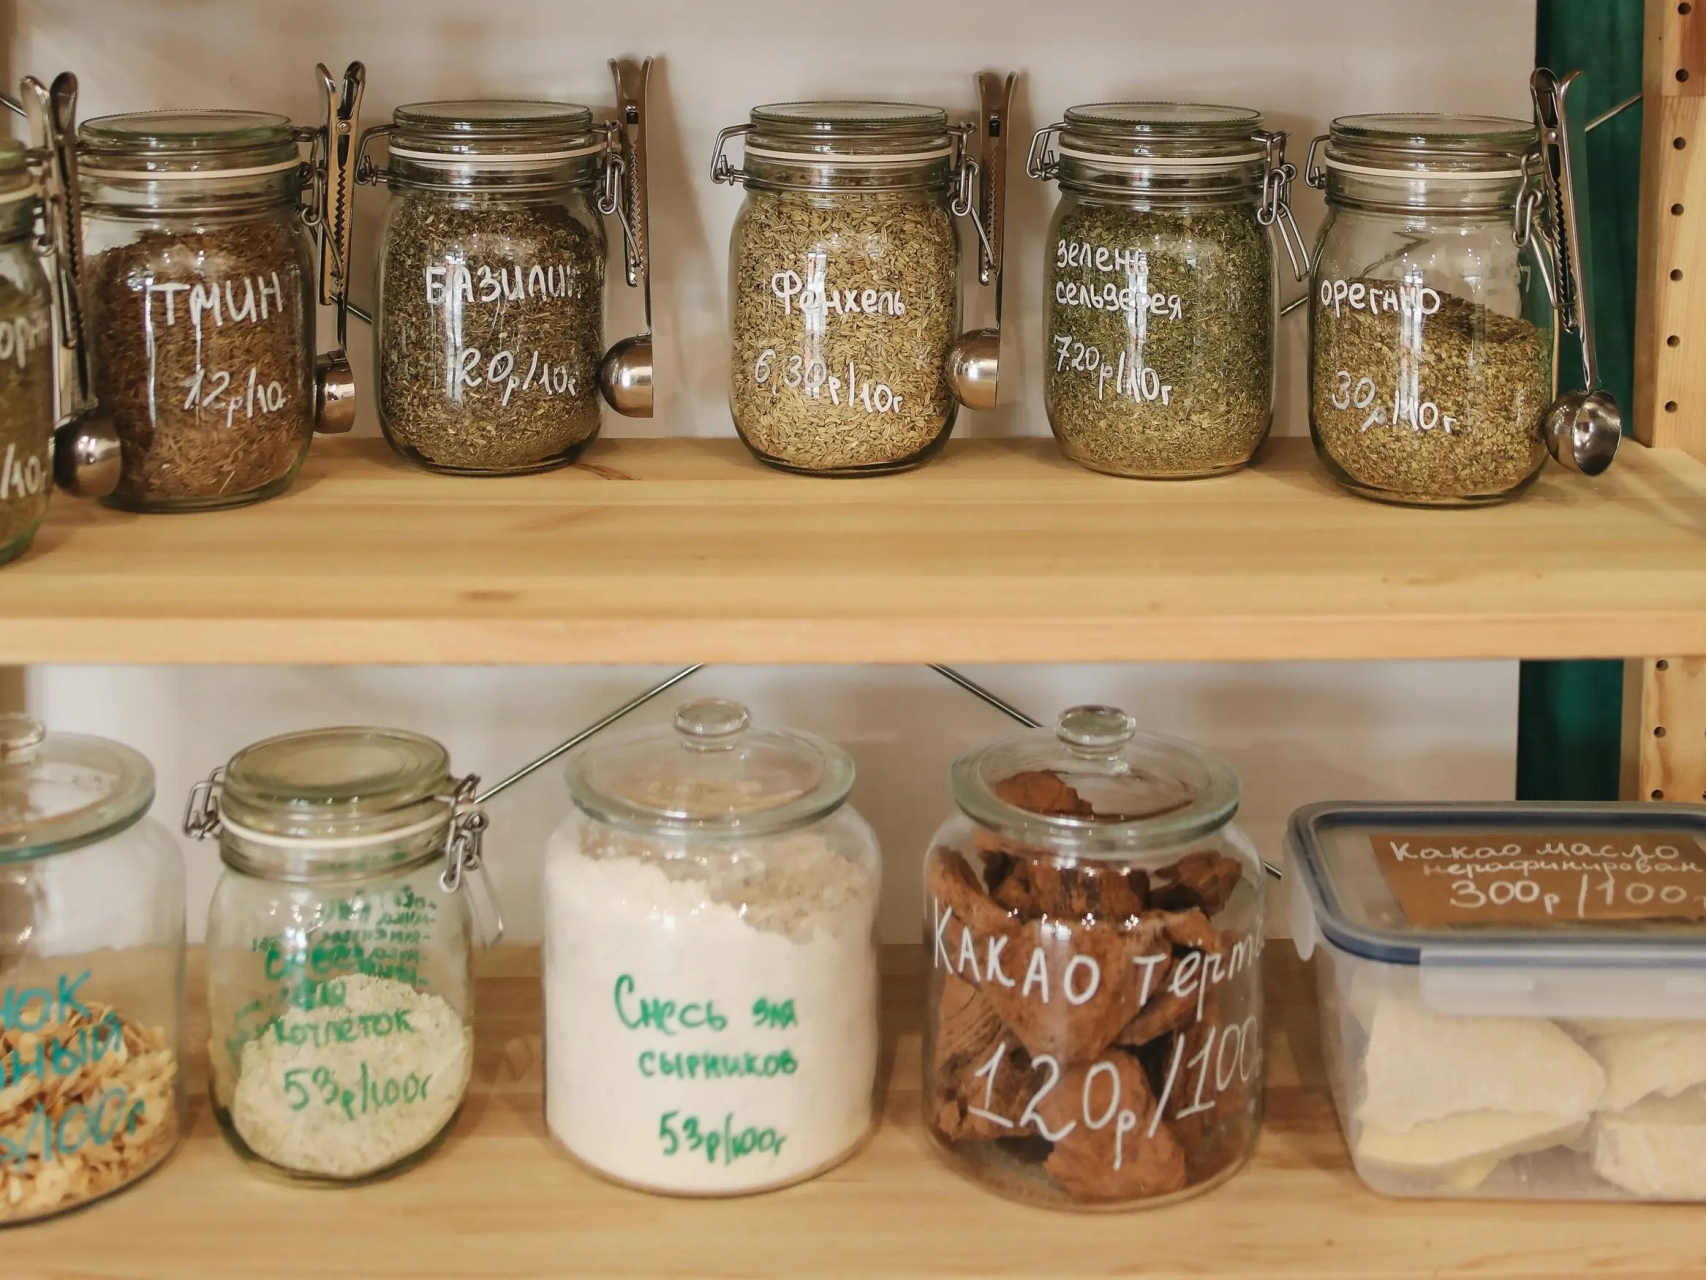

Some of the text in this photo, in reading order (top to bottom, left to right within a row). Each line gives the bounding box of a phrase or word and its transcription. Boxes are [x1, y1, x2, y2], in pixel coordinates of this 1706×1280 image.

[151, 271, 283, 327] ТМИН
[771, 270, 906, 316] Фенхель
[1055, 281, 1183, 322] сельдерея
[934, 896, 1100, 1006] КАКАО
